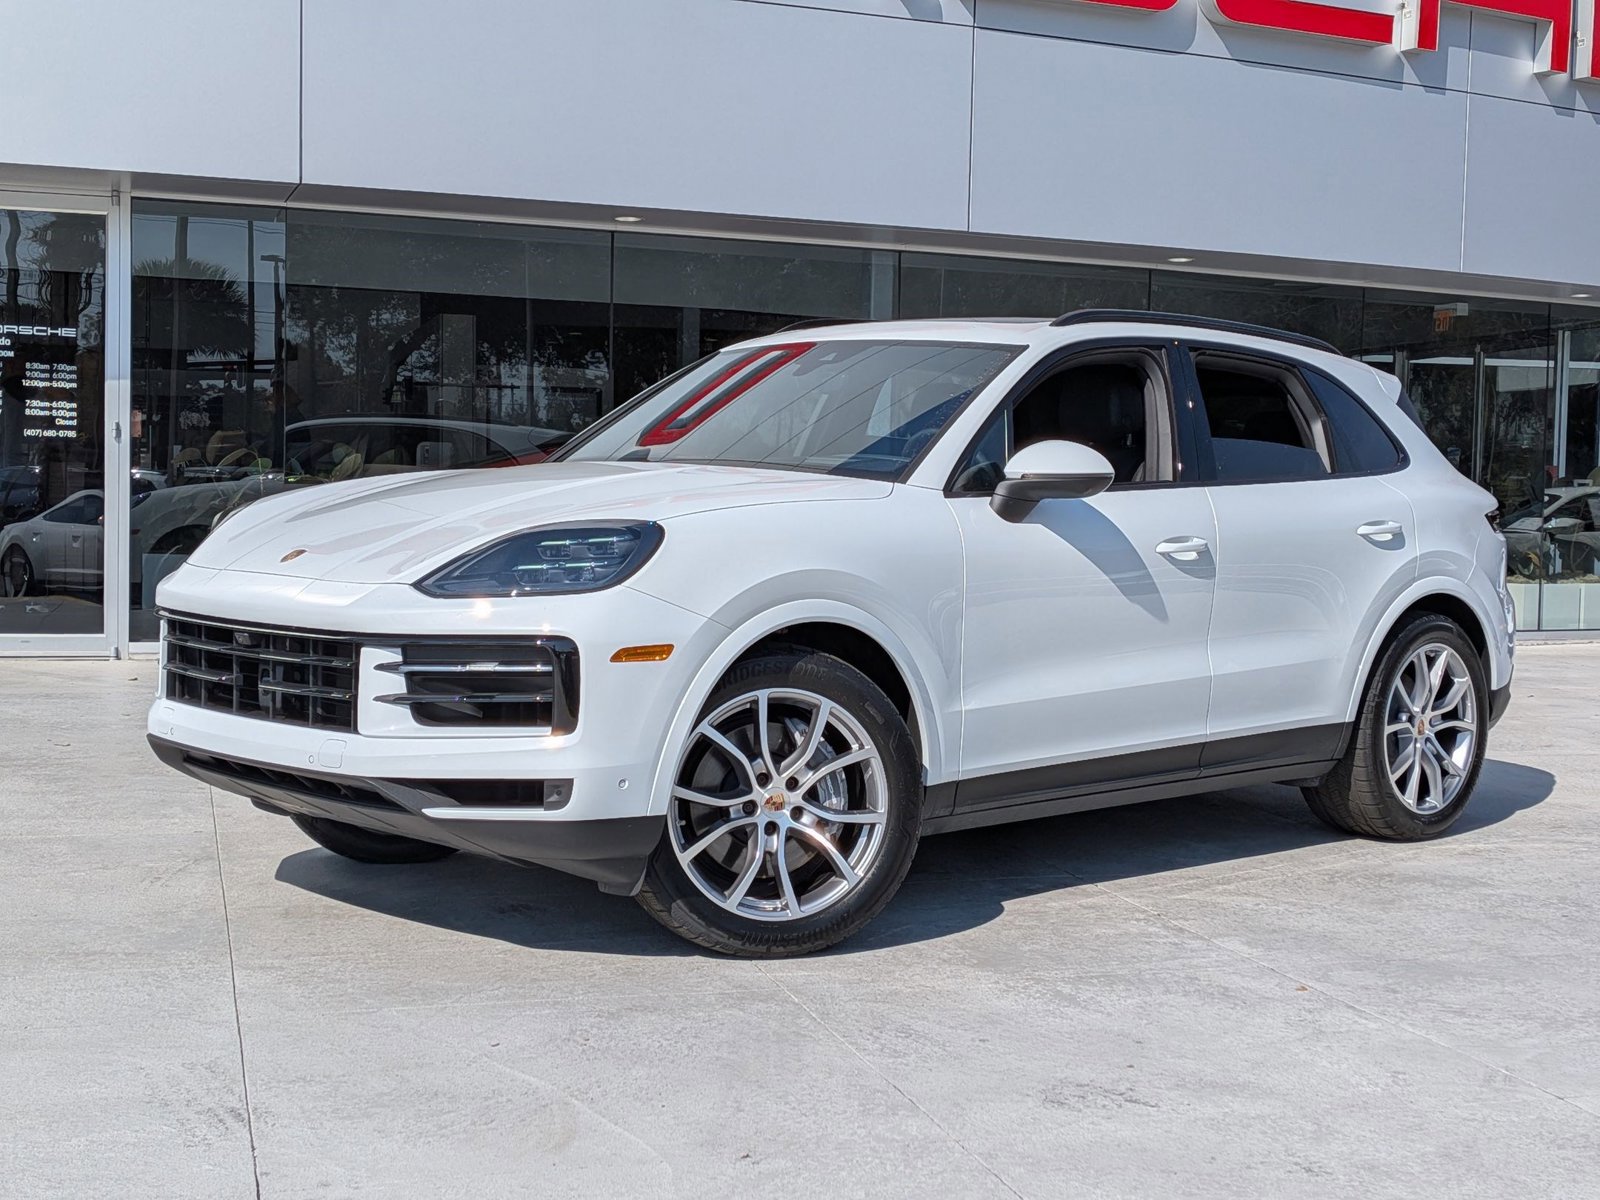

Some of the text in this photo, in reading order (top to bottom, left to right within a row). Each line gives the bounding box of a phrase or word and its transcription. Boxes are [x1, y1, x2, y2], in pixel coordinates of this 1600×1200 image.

[0, 325, 77, 338] RSCHE
[55, 418, 77, 426] Closed
[23, 428, 77, 438] (407) 680-0785
